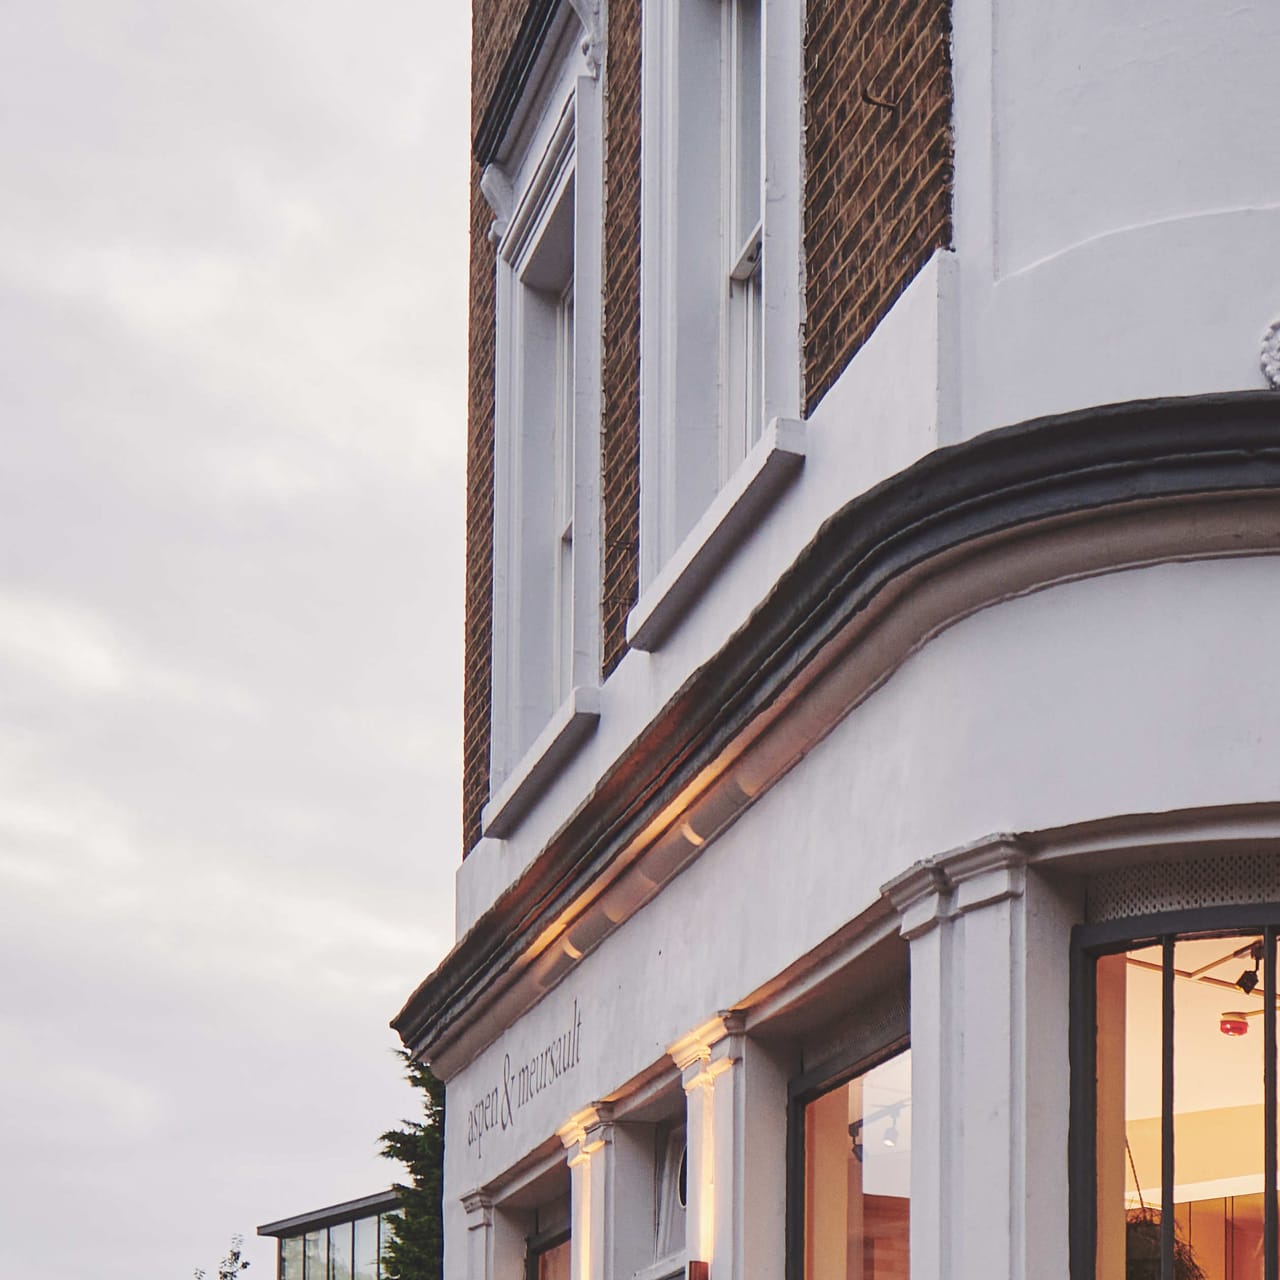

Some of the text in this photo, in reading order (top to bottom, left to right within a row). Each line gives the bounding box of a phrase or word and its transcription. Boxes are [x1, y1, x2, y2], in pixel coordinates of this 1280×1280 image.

[468, 999, 582, 1159] aspen & meursault
